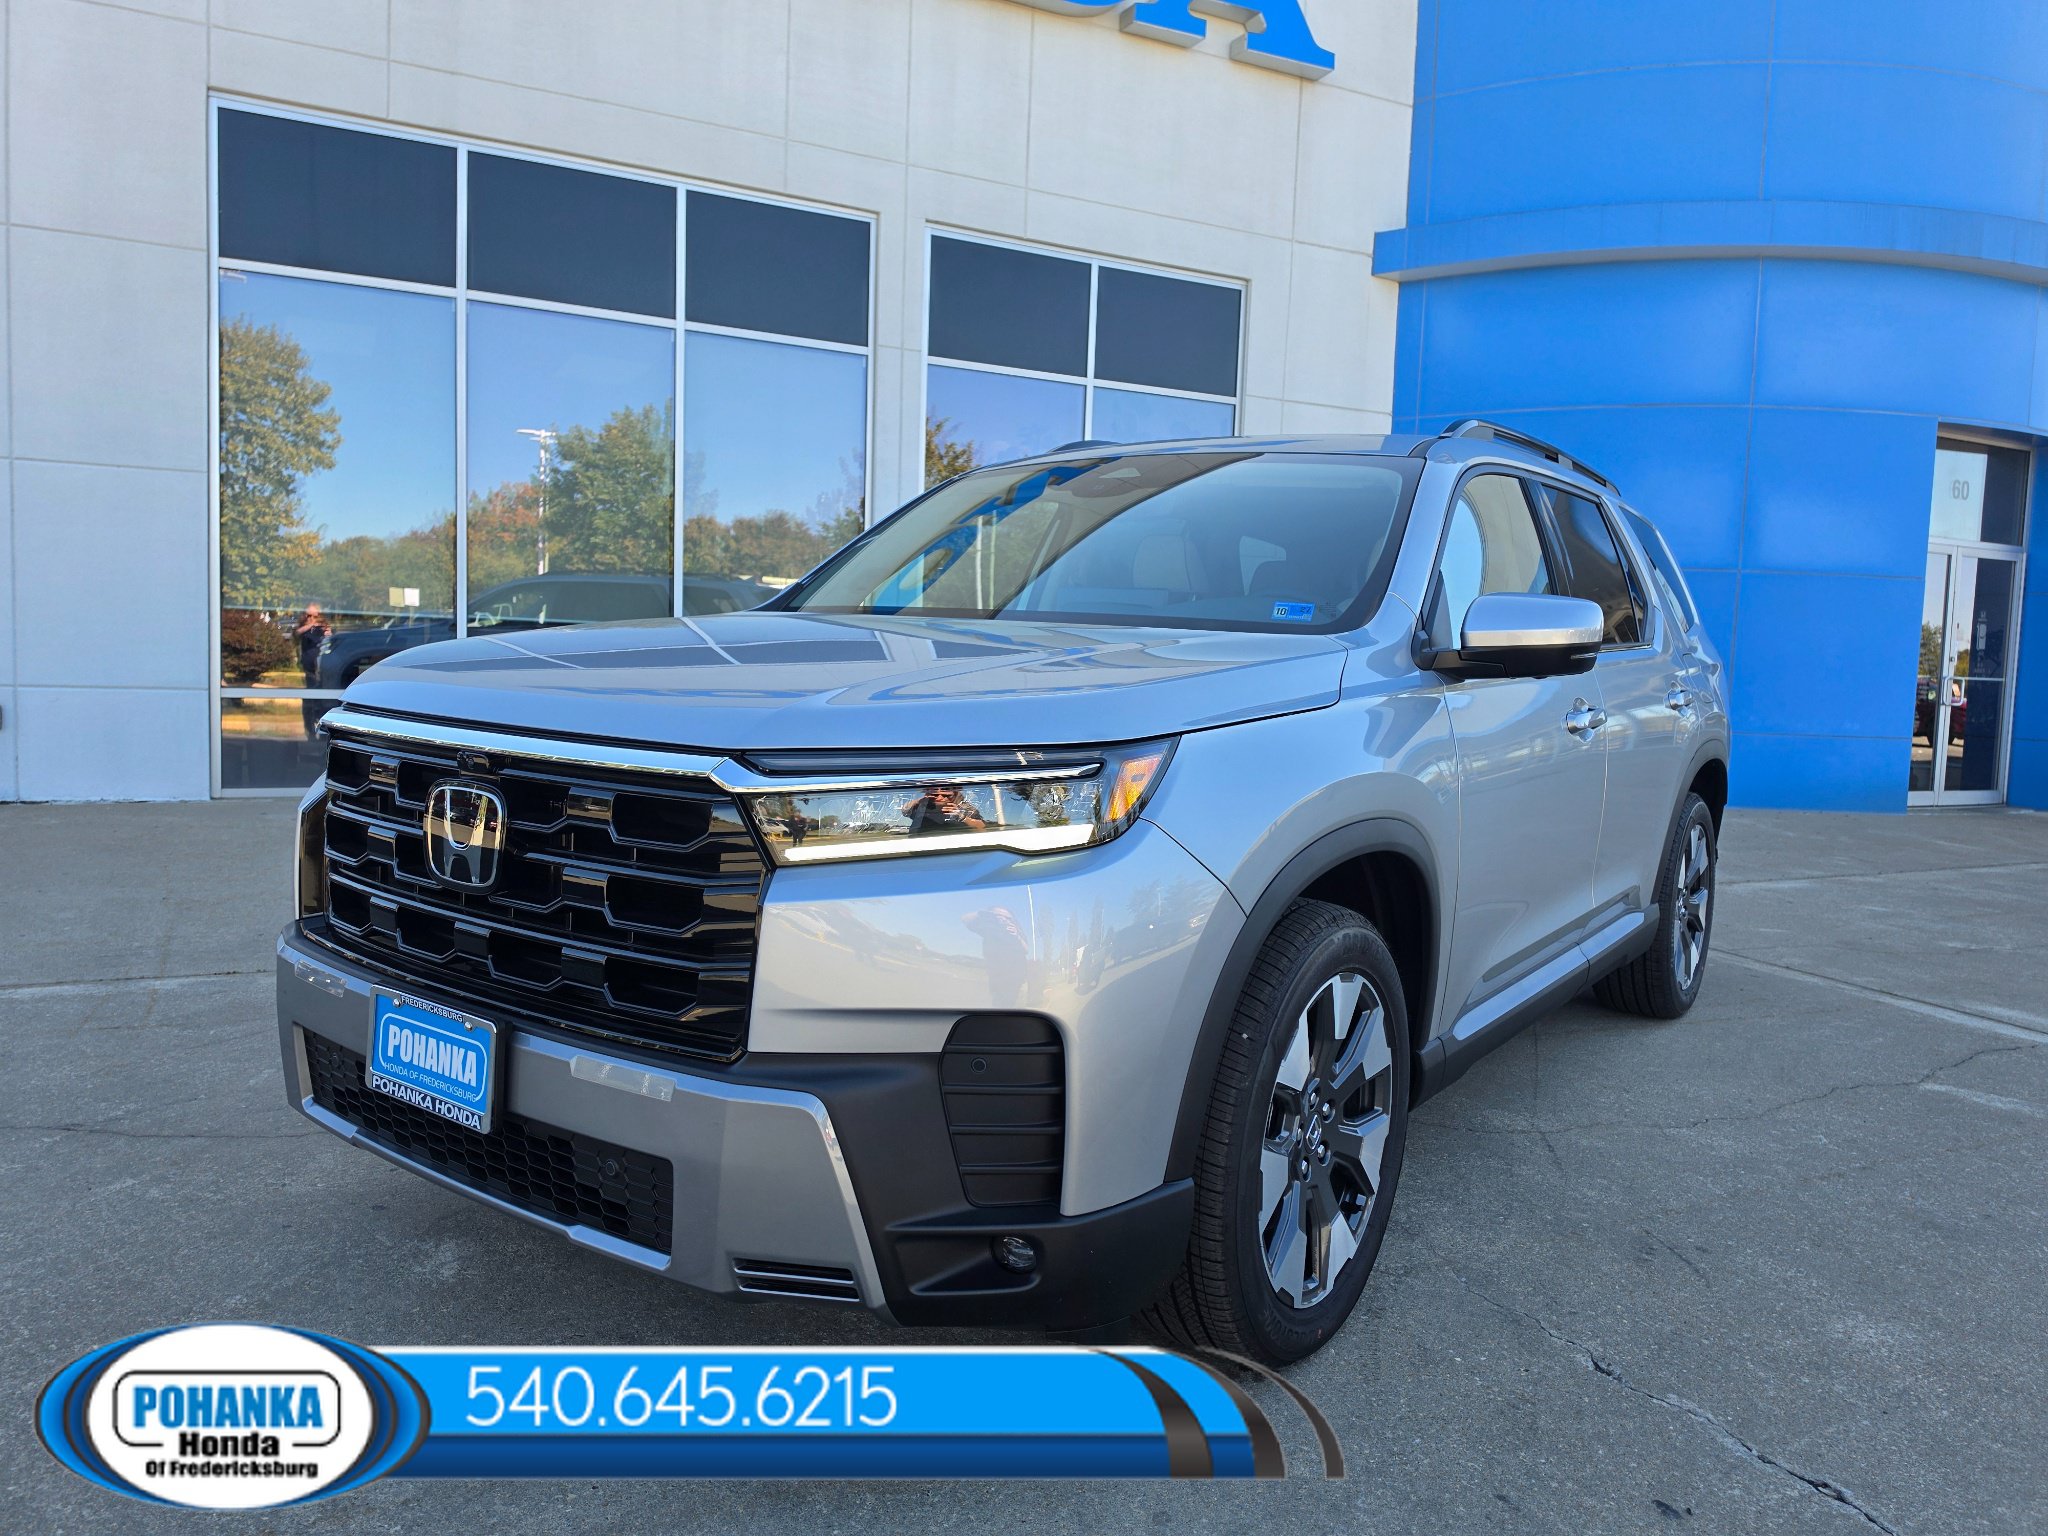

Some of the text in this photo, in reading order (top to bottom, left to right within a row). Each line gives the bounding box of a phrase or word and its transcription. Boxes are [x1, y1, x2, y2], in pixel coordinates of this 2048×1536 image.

[1952, 479, 1970, 501] 60
[1276, 607, 1288, 616] 10
[401, 996, 463, 1022] FREDERICKSBURG
[387, 1024, 477, 1087] POHANKA
[384, 1062, 477, 1102] HONDA OF FREDERICKSBURG
[372, 1075, 481, 1130] POHANKA HONDA
